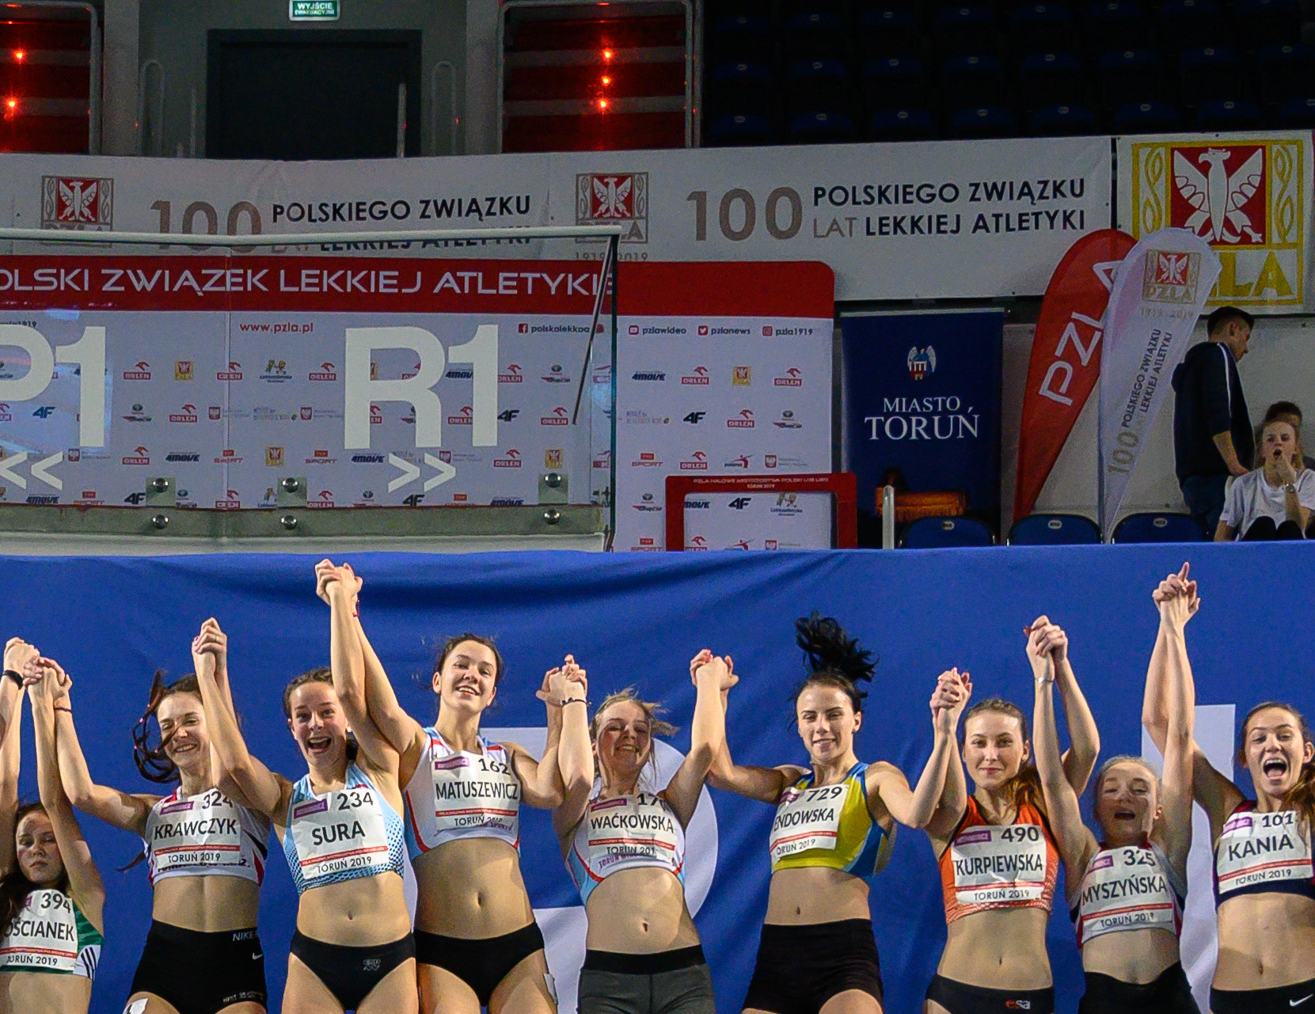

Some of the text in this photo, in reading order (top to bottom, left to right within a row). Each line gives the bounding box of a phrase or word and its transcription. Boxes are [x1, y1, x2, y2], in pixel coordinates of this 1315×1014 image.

[688, 178, 1085, 241] 100 POLSKIEGO ZWIĄZKU
[150, 200, 262, 253] 100
[272, 200, 411, 223] POLSKIEGO
[419, 196, 531, 222] ZWIĄZKU
[814, 209, 1084, 238] LAT LEKKIEJ ATLETYKI
[101, 268, 269, 297] ZWIĄZEK
[279, 270, 422, 294] LEKKIEJ
[240, 322, 313, 334] www.pzla.pl
[642, 326, 813, 337] pzlawideo pzlanews pzla1919
[1140, 332, 1172, 413] LEKKIEJ ATLETYKI
[344, 324, 499, 449] R1
[884, 395, 961, 413] MIASTO
[1108, 329, 1161, 475] 100 POLSKIEGO ZWIĄZKU
[864, 406, 981, 441] TORUŃ
[729, 497, 751, 509] 4F
[477, 758, 511, 776] 162
[202, 791, 233, 810] 324
[435, 782, 519, 801] MATUSZEWICZ
[806, 786, 842, 802] 729
[336, 791, 374, 812] 234
[154, 817, 237, 840] KRAWCZYK
[454, 814, 485, 826] TORUŃ
[590, 812, 674, 833] WAĆKOWSKA
[774, 808, 834, 833] ENDOWSKA
[1262, 814, 1294, 828] 101
[311, 820, 366, 845] SURA
[1000, 827, 1039, 843] 490
[776, 838, 816, 855] ORUŃ 2019
[1228, 834, 1294, 862] KANIA
[168, 852, 221, 863] TORUŃ 2019
[317, 857, 348, 874] TORUŃ
[350, 856, 372, 867] 2019
[956, 854, 1043, 876] KURPIEWSKA
[1123, 849, 1156, 867] 325
[1235, 869, 1292, 886] TORUŃ 2019
[974, 888, 1030, 901] TORUŃ 2019
[1082, 874, 1168, 905] MYSZYŃSKA
[40, 892, 71, 914] 394
[3, 918, 75, 942] OŚCIANEK
[1100, 913, 1132, 928] TORUŃ
[232, 931, 254, 942] NIKE
[36, 957, 58, 967] 2019
